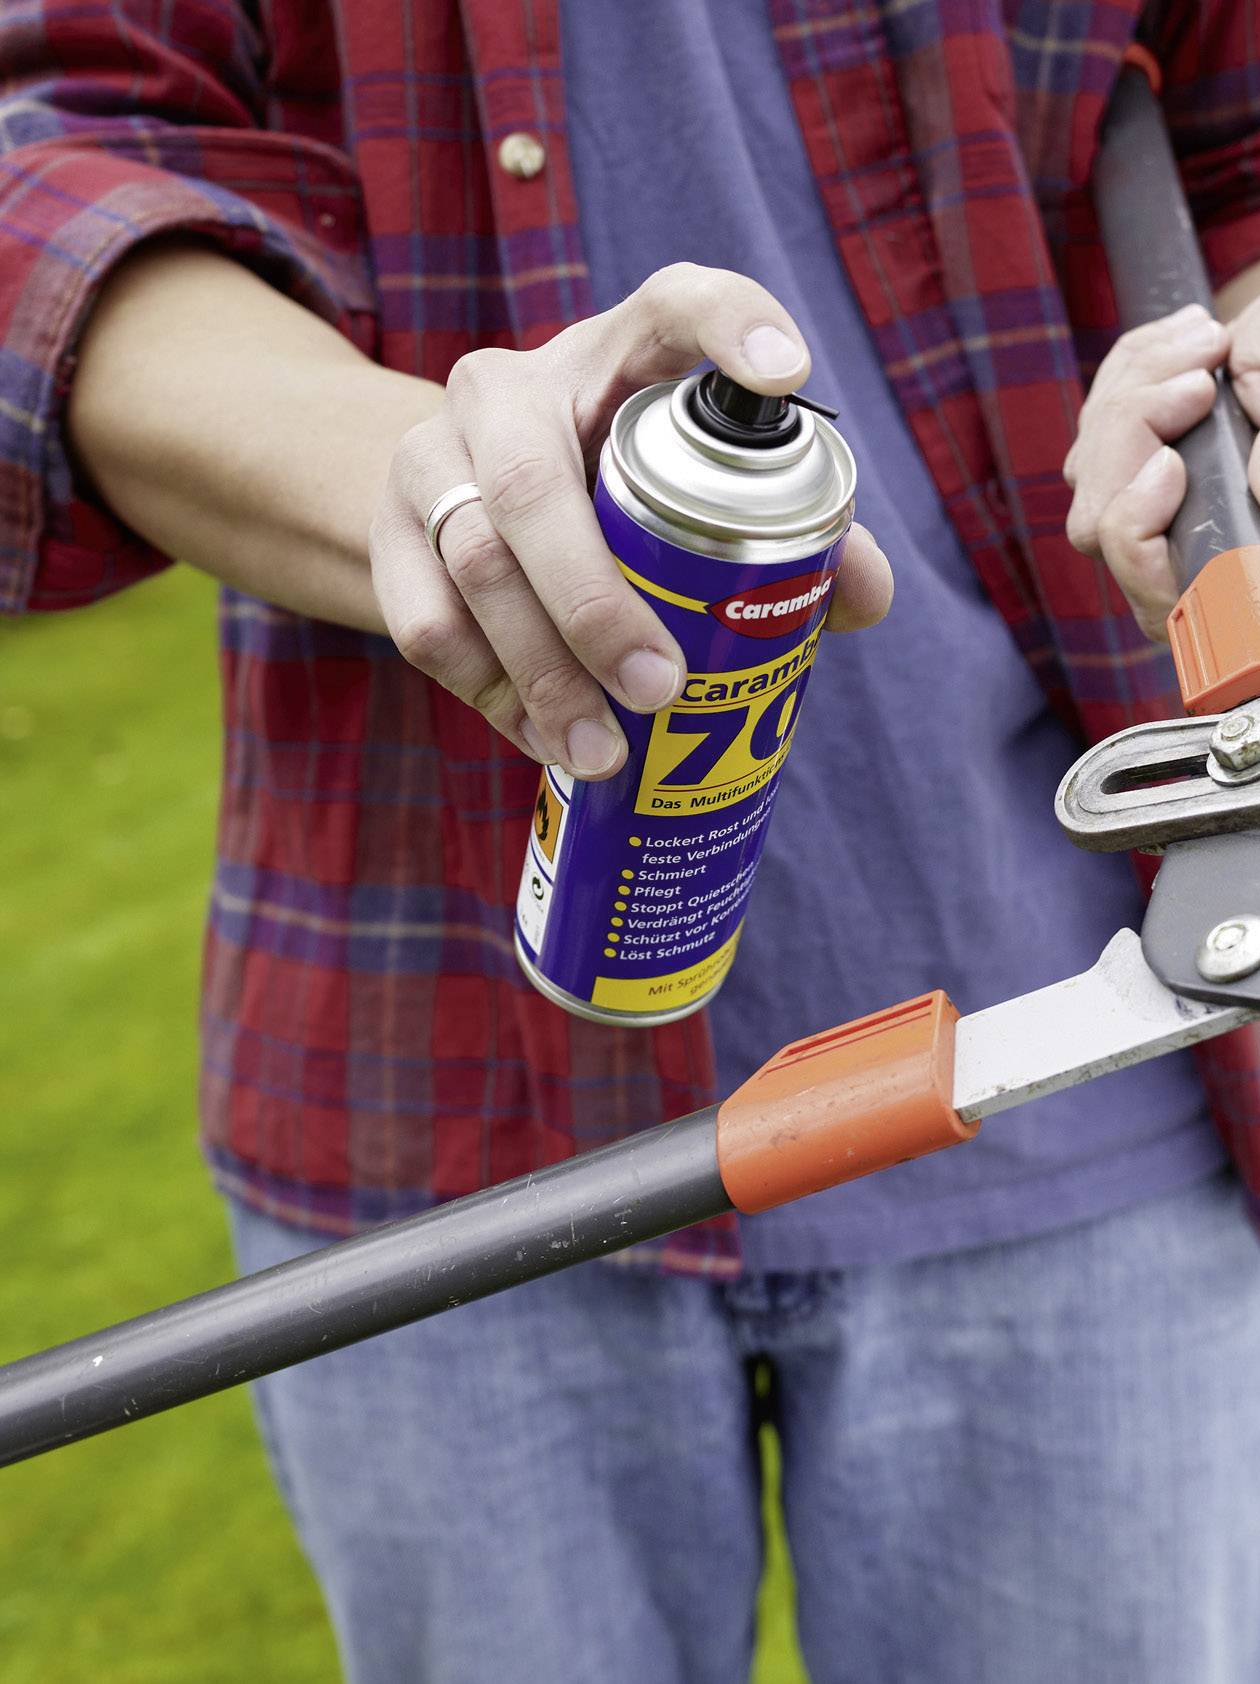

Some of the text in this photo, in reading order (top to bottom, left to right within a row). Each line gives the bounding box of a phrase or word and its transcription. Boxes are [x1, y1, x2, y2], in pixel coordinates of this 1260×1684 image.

[725, 576, 832, 620] Caramba
[657, 665, 812, 786] 70
[651, 797, 681, 810] Das
[646, 801, 764, 848] Lockert Rost und
[642, 852, 681, 864] feste
[638, 865, 707, 881] Schmiert
[634, 886, 682, 898] Pflegt
[630, 901, 683, 914] Stoppt
[627, 910, 703, 929] Verdrängt
[623, 931, 681, 945] Schützt
[685, 922, 708, 937] vor
[619, 931, 716, 960] Löst Schmutz
[648, 984, 673, 996] Mit
